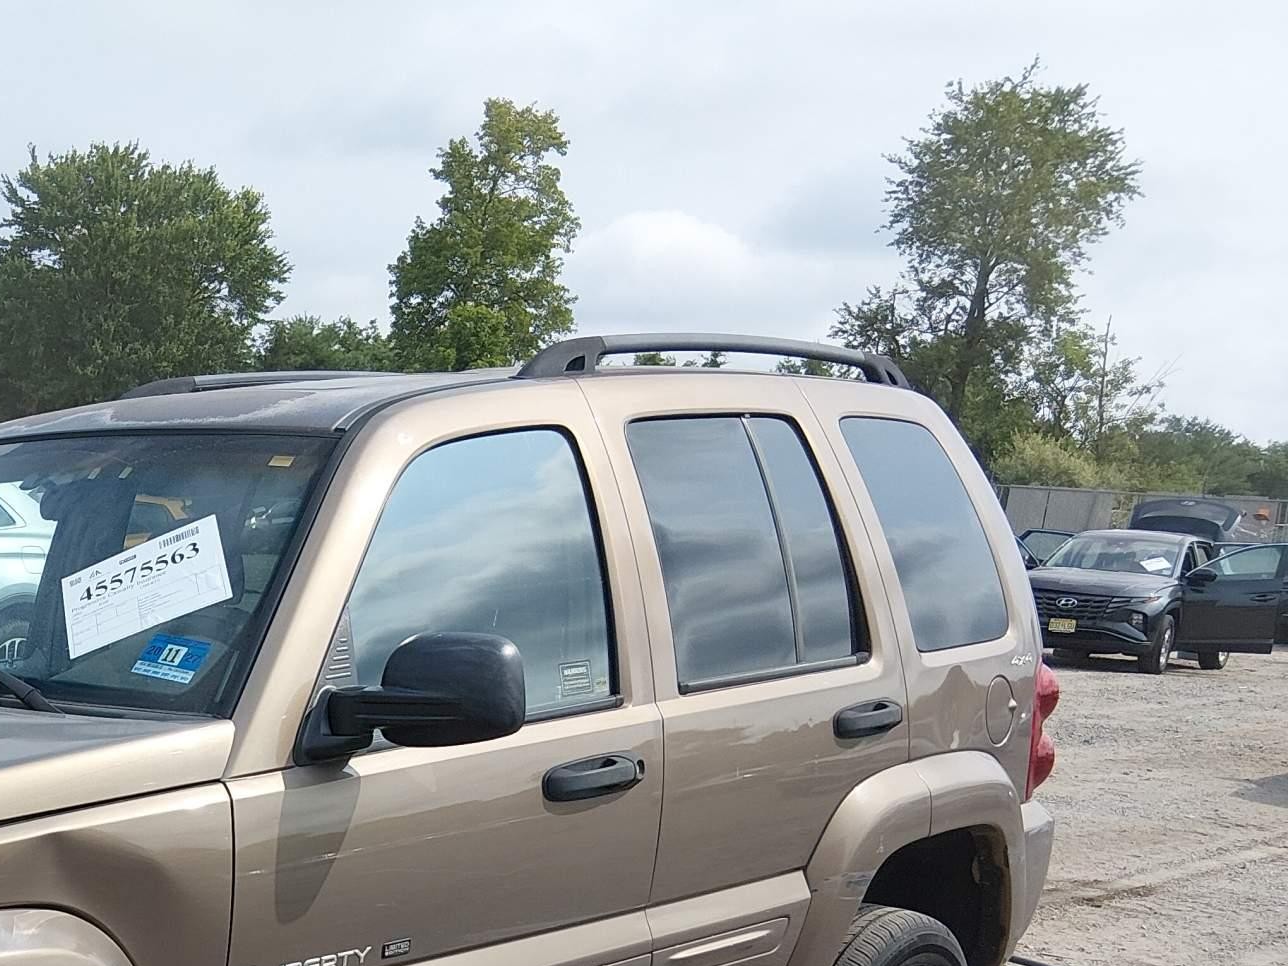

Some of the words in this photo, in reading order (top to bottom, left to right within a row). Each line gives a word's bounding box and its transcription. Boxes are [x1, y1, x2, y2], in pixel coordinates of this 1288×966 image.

[79, 542, 200, 602] 45575563
[162, 647, 181, 664] 11
[385, 941, 410, 951] LIMITED
